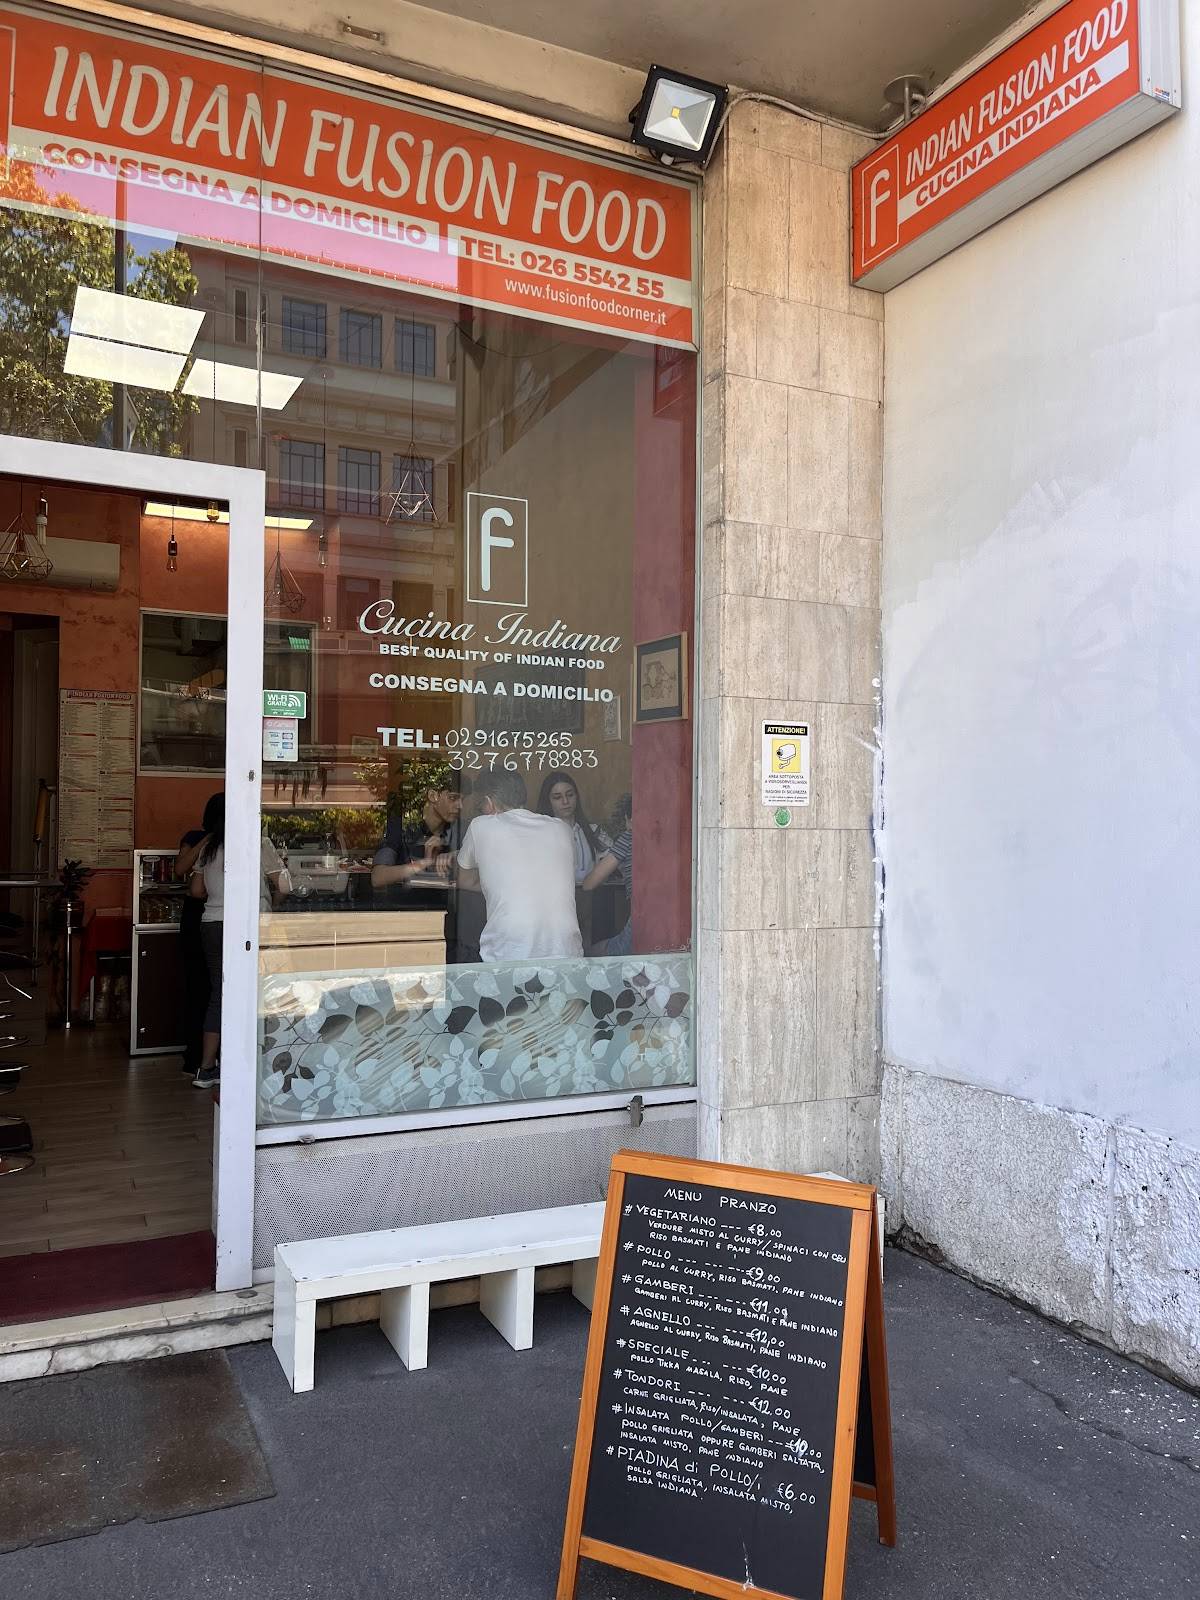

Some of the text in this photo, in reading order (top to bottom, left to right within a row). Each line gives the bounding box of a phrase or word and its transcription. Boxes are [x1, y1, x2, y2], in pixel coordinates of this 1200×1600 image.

[905, 0, 1128, 186] INDIAN FUSION FOOD
[43, 45, 667, 261] INDIAN FUSION FOOD
[916, 65, 1102, 207] CUCINA INDIANA
[43, 141, 428, 246] CONSEGNA A DOMICILIO
[461, 234, 664, 300] TEL: 026 5542 55
[504, 275, 667, 326] www.fusionfoodcorner.it
[359, 599, 623, 653] Cucina Indiana
[379, 643, 605, 671] BEST QUALITY OF INDIAN FOOD
[369, 673, 614, 703] CONSEGNA A DOMICILIO
[376, 726, 573, 749] TEL: 0291675265
[767, 726, 806, 735] ATTENZIONE!
[447, 749, 599, 773] 3276778283
[636, 1204, 717, 1227] VEGETARIANO
[663, 1188, 777, 1215] MENU PRANZO
[636, 1244, 671, 1260] POLLO
[648, 1219, 683, 1233] VERDURE
[689, 1227, 715, 1238] MISTO
[718, 1232, 729, 1240] AL
[812, 1250, 829, 1260] CON
[649, 1231, 792, 1263] RISO BASMATI E PANE INDIANO
[634, 1274, 694, 1295] GAMBERI
[641, 1259, 665, 1269] POLLO
[669, 1264, 679, 1273] AL
[718, 1274, 737, 1283] RISO
[782, 1286, 805, 1298] PANE
[809, 1293, 843, 1307] INDIANO
[633, 1306, 691, 1326] AGNELLO
[634, 1287, 667, 1301] GAMBERI
[671, 1295, 681, 1303] AL
[715, 1303, 733, 1313] RISO
[736, 1308, 769, 1323] BASMATI
[771, 1317, 777, 1326] E
[779, 1318, 798, 1330] PANE
[801, 1323, 838, 1337] INDIANO
[627, 1339, 690, 1360] SPECIALE
[629, 1319, 660, 1331] AGNELLO
[663, 1325, 674, 1334] AL
[704, 1331, 720, 1343] RISO
[759, 1346, 781, 1358] PANE
[787, 1353, 827, 1369] INDIANO
[624, 1368, 681, 1392] TONDORI
[630, 1354, 654, 1364] POLLO
[760, 1383, 789, 1396] PANE
[623, 1387, 649, 1398] CARNE
[772, 1421, 801, 1437] PANE
[625, 1402, 670, 1420] INSALATA
[620, 1430, 657, 1445] INSALATA
[698, 1446, 720, 1458] PANE
[725, 1454, 764, 1469] INDIANO
[621, 1418, 648, 1430] POLLO
[701, 1435, 735, 1449] OPPURE
[739, 1442, 777, 1460] GAMBERI
[617, 1445, 679, 1472] PIADINA
[684, 1461, 699, 1474] di
[627, 1475, 654, 1485] SALSA
[627, 1465, 652, 1476] POLLO
[712, 1484, 756, 1501] INSALATA
